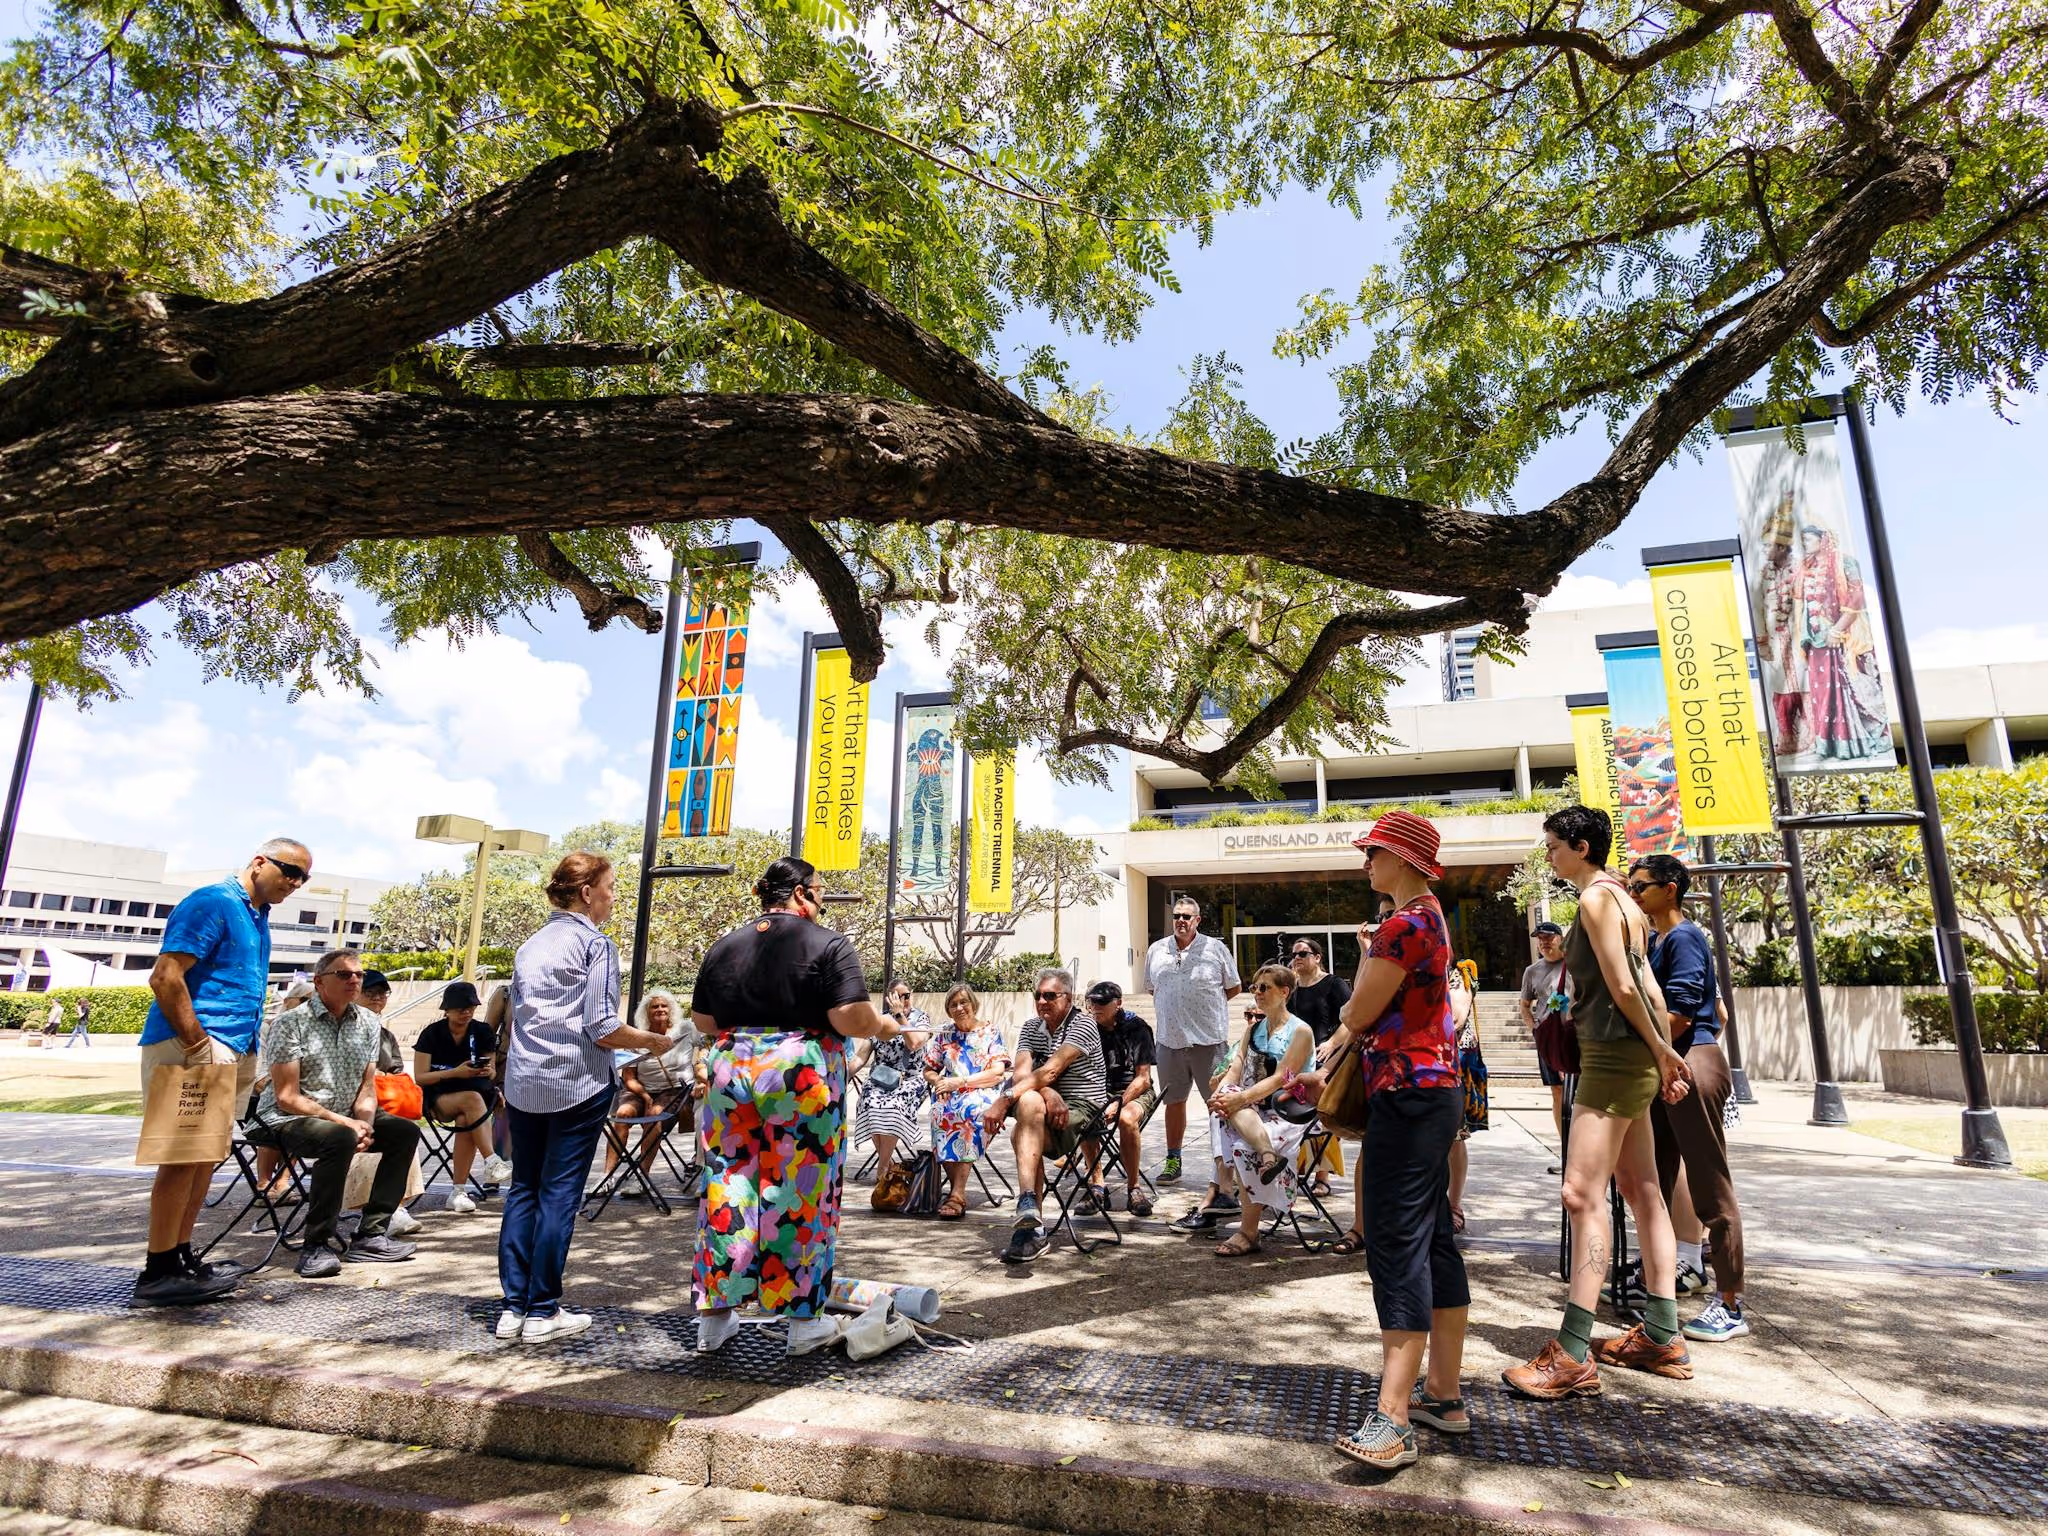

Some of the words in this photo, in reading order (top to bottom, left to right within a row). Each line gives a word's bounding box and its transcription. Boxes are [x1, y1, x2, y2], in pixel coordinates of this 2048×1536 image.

[1666, 589, 1699, 692] crosses
[1711, 641, 1740, 682] Art
[818, 694, 837, 735] you
[842, 713, 863, 759] that
[1601, 718, 1614, 747] ASIA
[1718, 688, 1750, 747] that
[1604, 750, 1620, 799] PACIFIC
[1682, 699, 1718, 810] borders
[814, 741, 834, 829] wonder
[837, 766, 857, 842] makes
[993, 787, 1003, 831] PACIFIC
[1224, 832, 1319, 849] QUEENSLAND
[1325, 831, 1352, 845] ART
[1611, 804, 1628, 869] TRIENNIAL
[991, 833, 1002, 893] TRIENNIAL
[179, 1100, 206, 1108] Read
[181, 1090, 209, 1099] Sleep
[182, 1082, 200, 1090] Eat
[177, 1108, 206, 1116] Local
